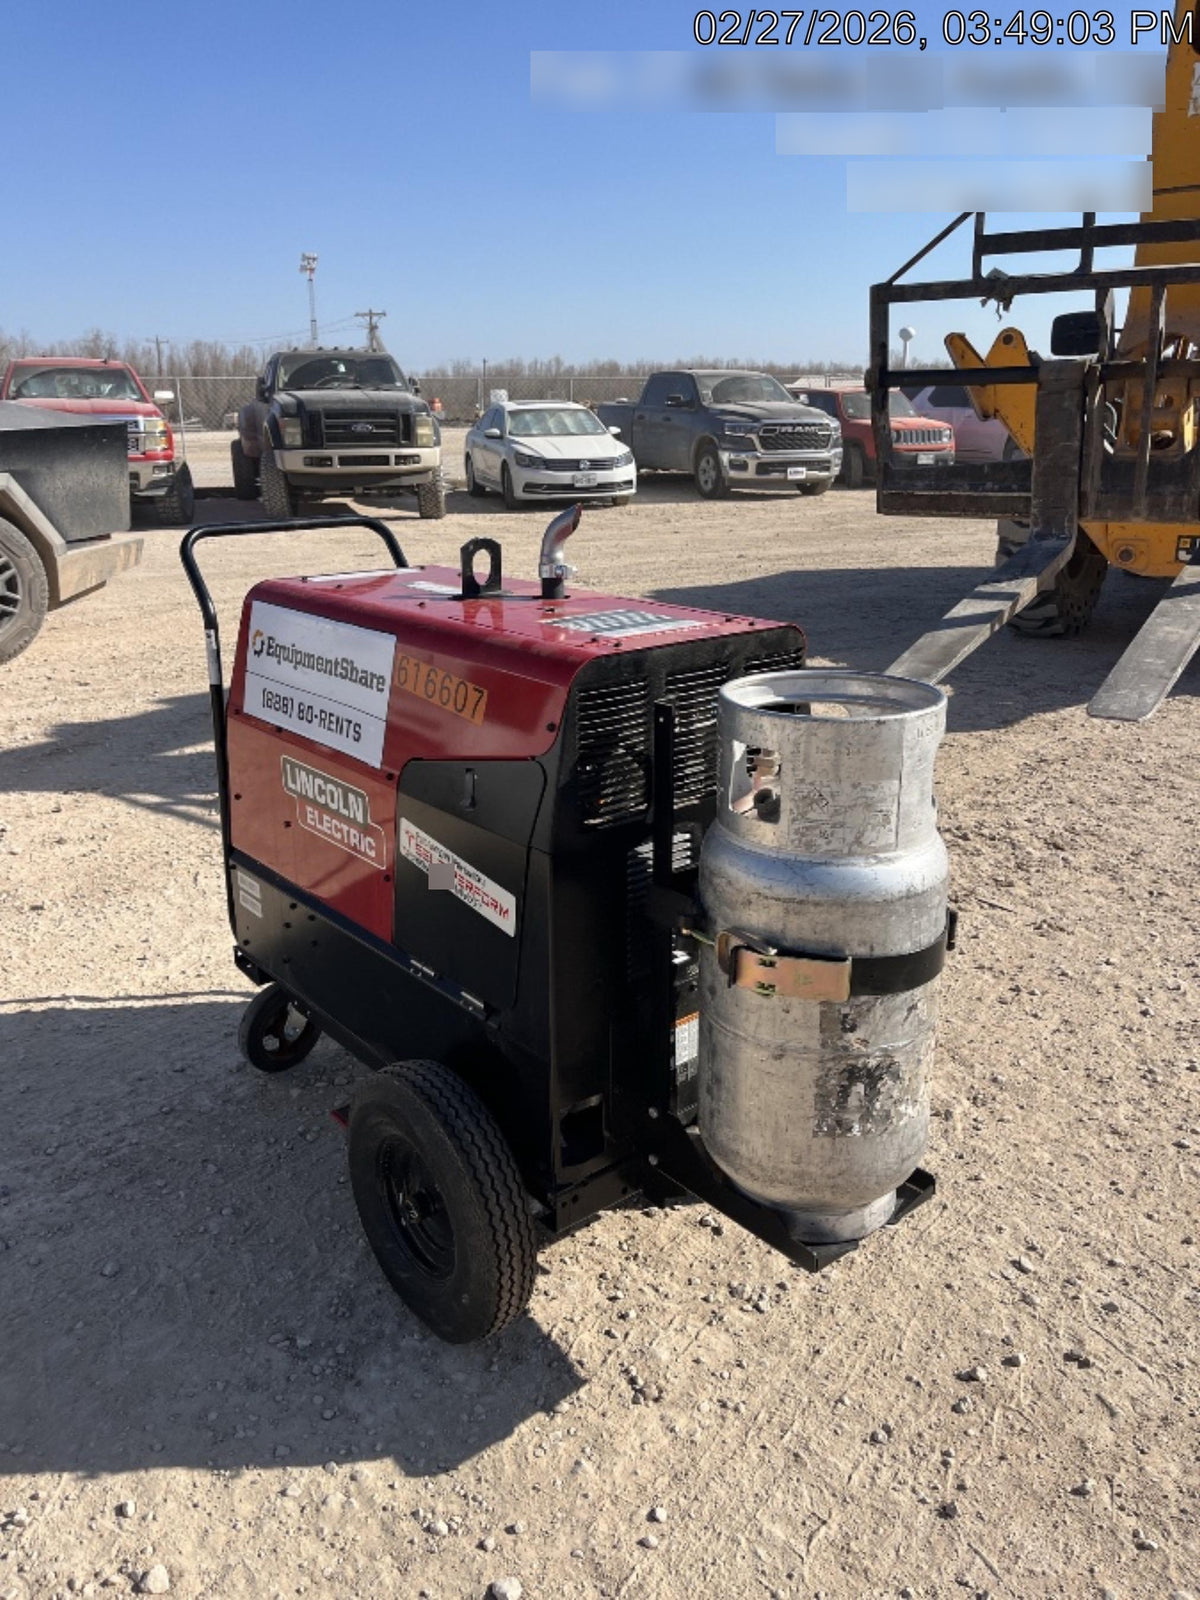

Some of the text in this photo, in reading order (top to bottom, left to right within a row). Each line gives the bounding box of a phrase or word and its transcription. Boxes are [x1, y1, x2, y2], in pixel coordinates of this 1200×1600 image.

[780, 425, 815, 433] RAM
[266, 635, 387, 694] EquipmentShare
[397, 655, 485, 719] 616607
[297, 701, 363, 743] 80-RENTS
[285, 763, 364, 825] LINCOLN
[304, 804, 377, 859] ELECTRIC
